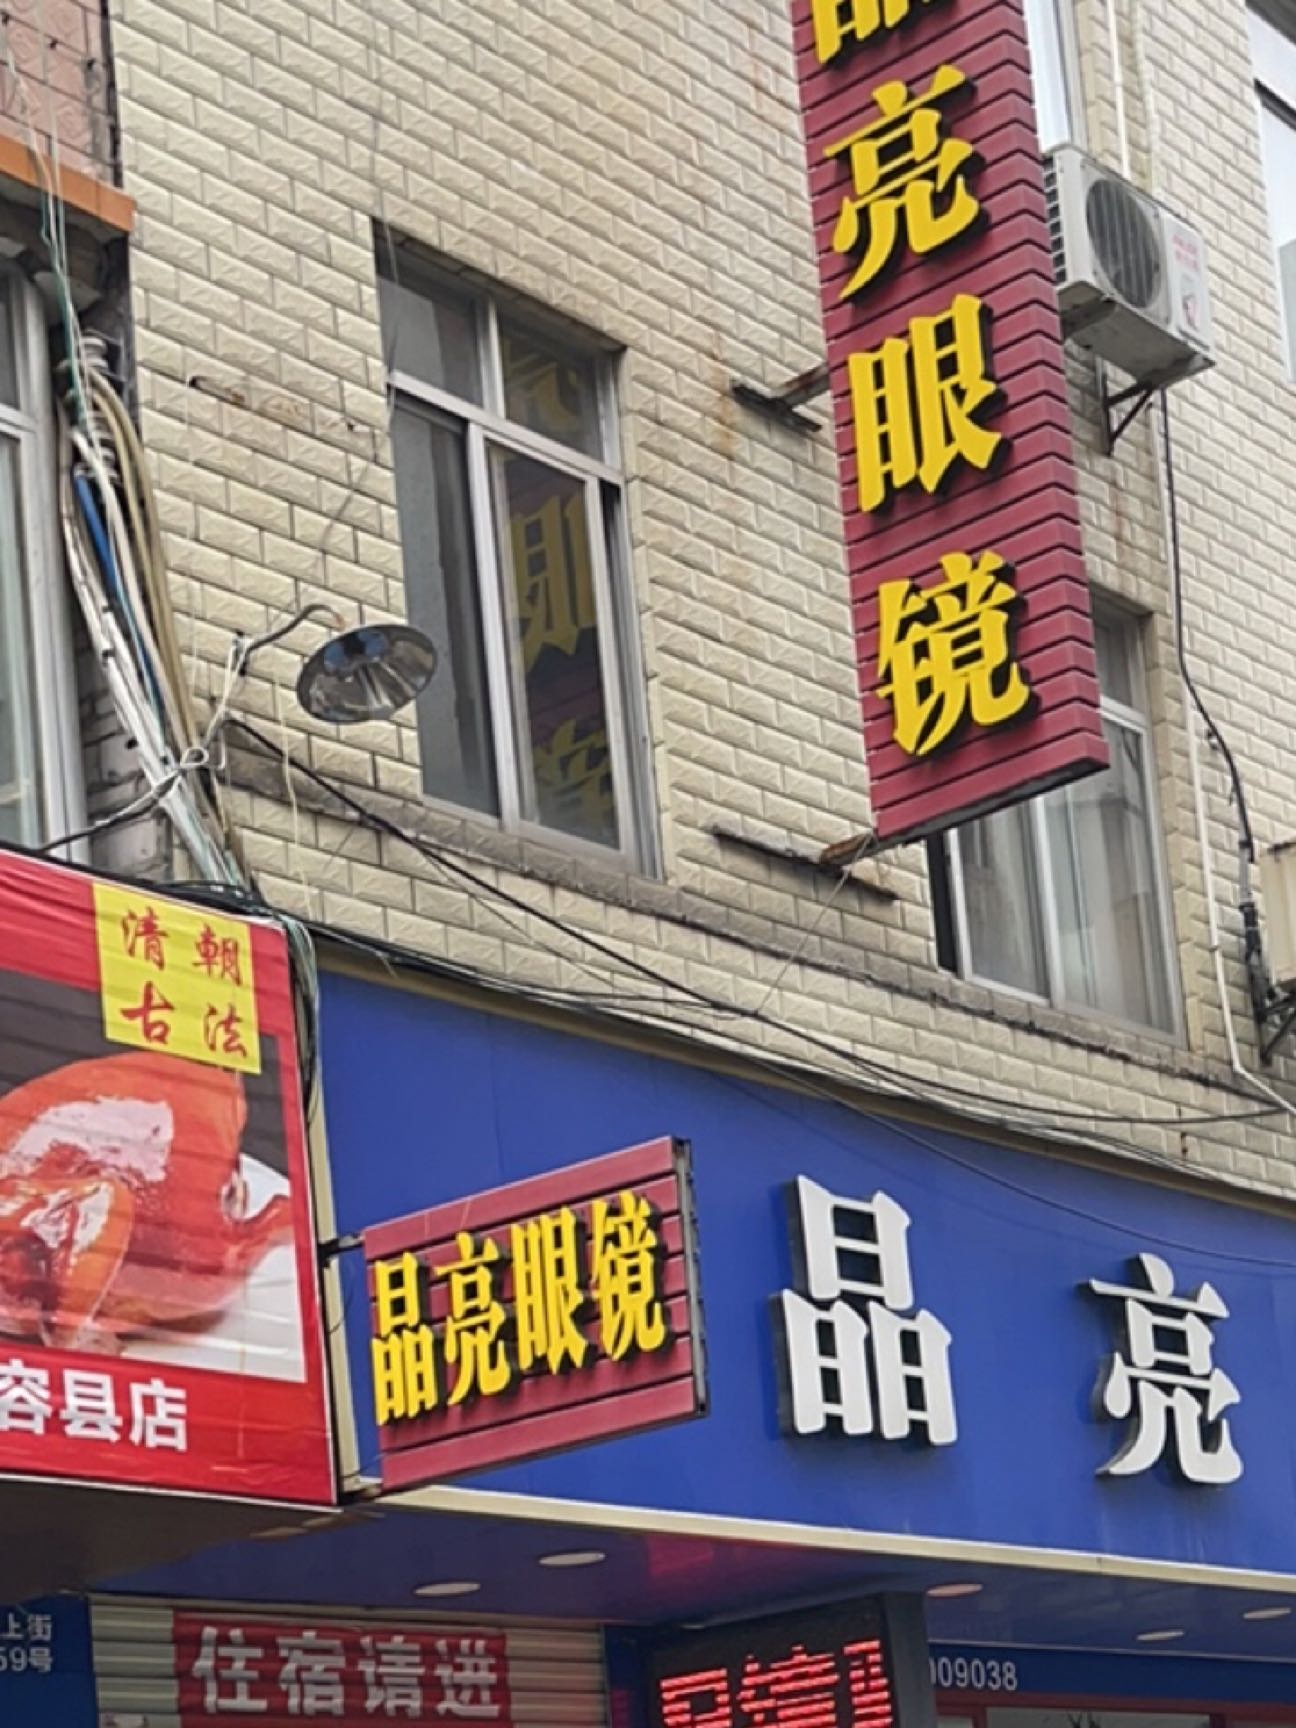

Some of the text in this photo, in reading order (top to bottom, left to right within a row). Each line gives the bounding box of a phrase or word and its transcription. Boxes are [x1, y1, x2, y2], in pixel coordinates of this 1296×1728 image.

[120, 905, 244, 989] 清朝
[120, 981, 250, 1059] 古法
[371, 1192, 668, 1426] 晶亮眼镜
[0, 1358, 188, 1453] 容县店
[191, 1626, 501, 1719] 住宿请进
